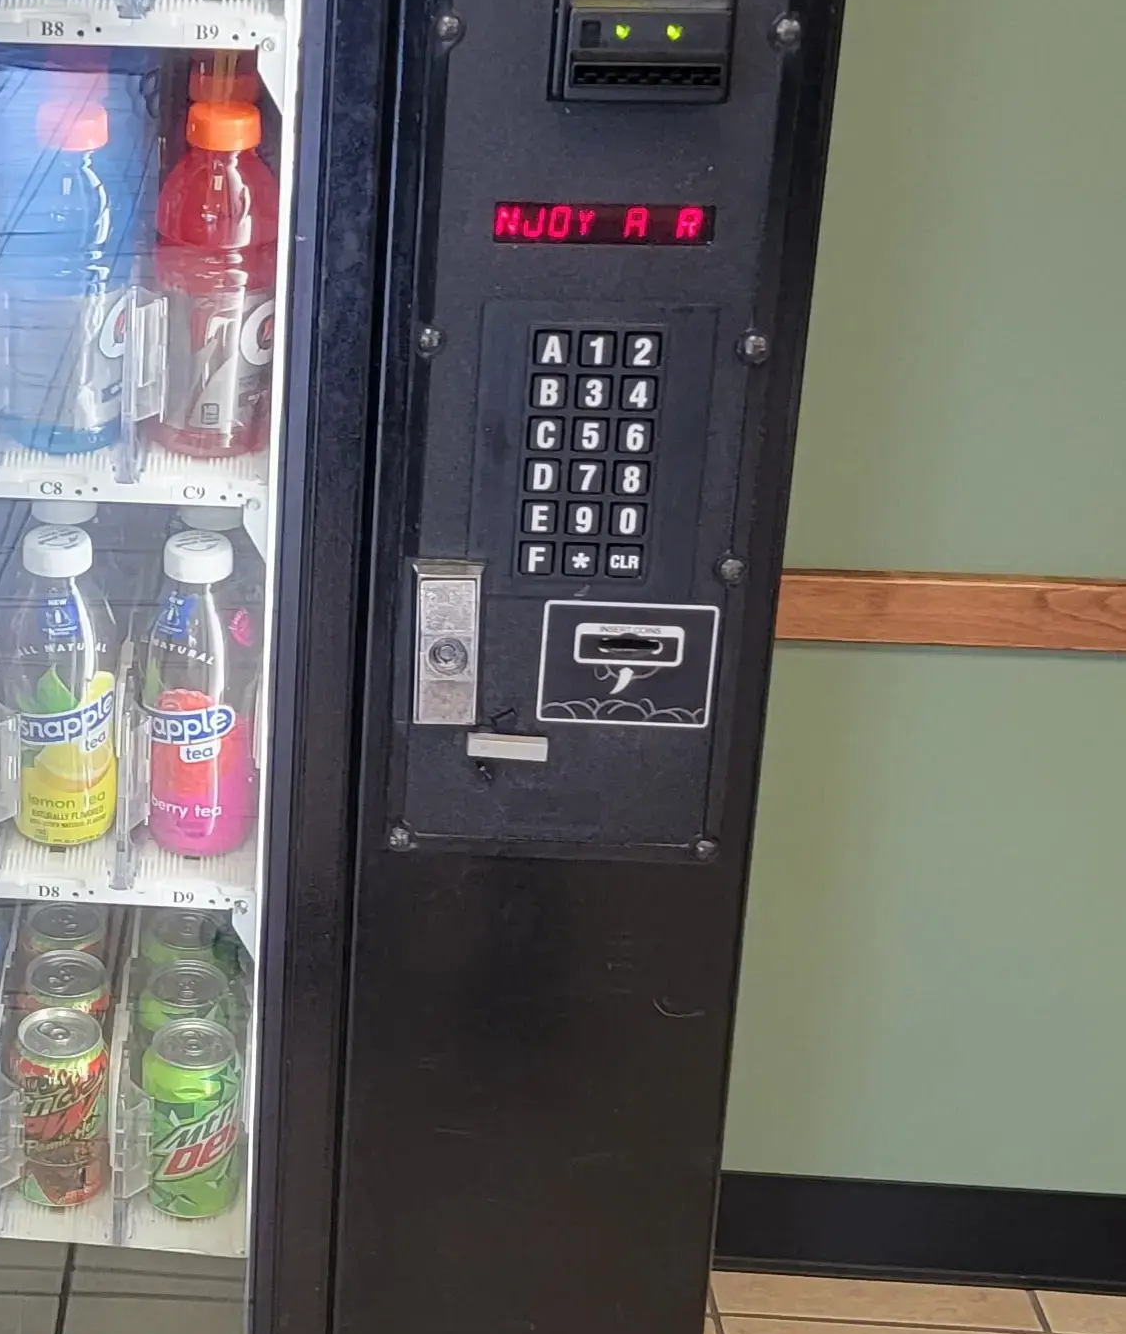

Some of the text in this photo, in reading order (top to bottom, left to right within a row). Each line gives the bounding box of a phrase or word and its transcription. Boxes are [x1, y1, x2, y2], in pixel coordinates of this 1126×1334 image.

[41, 20, 64, 37] B8
[196, 24, 219, 40] B9
[540, 335, 653, 366] A 1 2
[539, 378, 648, 409] B 3 4
[536, 420, 645, 452] C 5 6
[39, 481, 63, 495] C8
[532, 462, 641, 494] D 7 8
[182, 486, 206, 500] C9
[530, 504, 638, 535] E 9 0
[527, 546, 640, 573] F CLR
[20, 693, 115, 743] snapple
[152, 708, 228, 745] apple
[85, 731, 106, 752] tea
[185, 745, 214, 761] tea
[27, 791, 76, 809] lemon
[151, 793, 223, 819] berry tea
[38, 885, 60, 898] D8
[173, 891, 195, 904] D9
